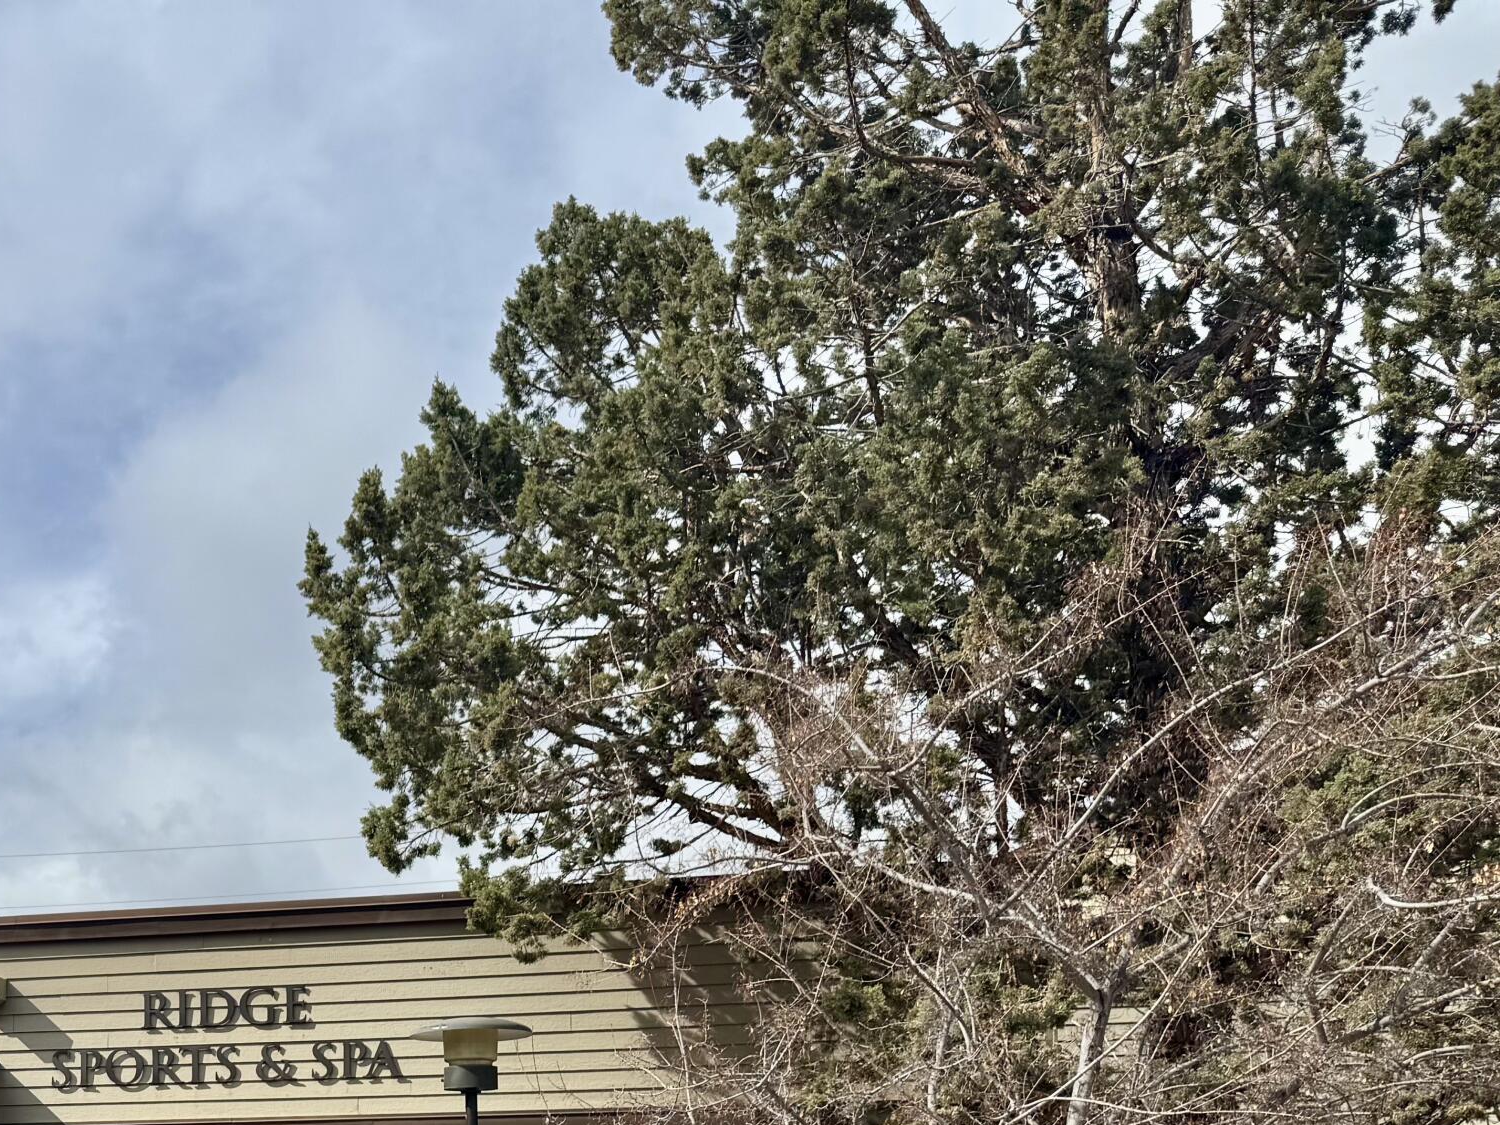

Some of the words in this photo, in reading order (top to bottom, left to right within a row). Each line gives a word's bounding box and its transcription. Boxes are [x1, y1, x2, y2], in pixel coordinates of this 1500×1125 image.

[142, 987, 315, 1032] RIDGE
[52, 1045, 241, 1092] SPORTS
[259, 1044, 304, 1087] &
[312, 1040, 409, 1084] SPA
